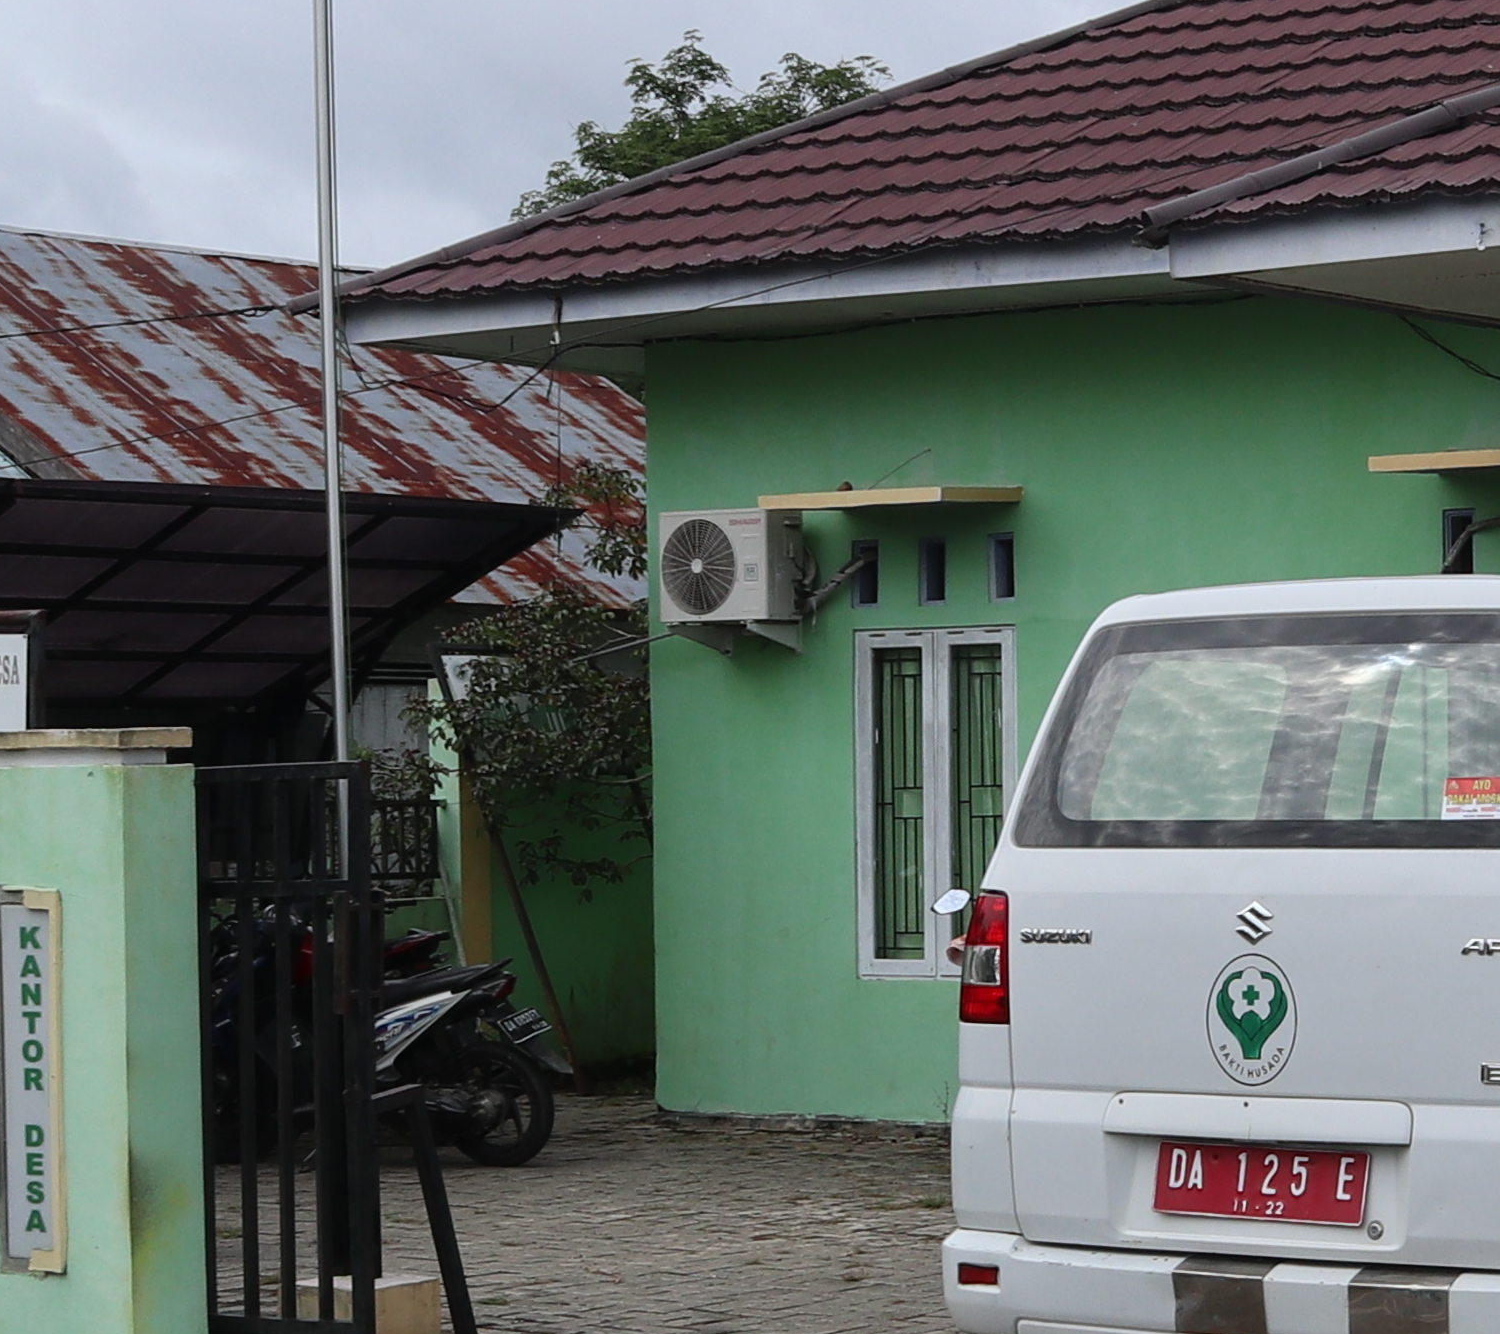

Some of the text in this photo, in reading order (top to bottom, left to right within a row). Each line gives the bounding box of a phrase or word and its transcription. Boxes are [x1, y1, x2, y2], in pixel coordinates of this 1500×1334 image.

[1473, 779, 1491, 791] AYO
[1020, 927, 1093, 945] SUZUKI
[1218, 1044, 1286, 1079] BAKTI HUSADA
[19, 926, 47, 1233] KANTOR DESA
[1168, 1148, 1204, 1190] DA
[1335, 1156, 1356, 1201] E
